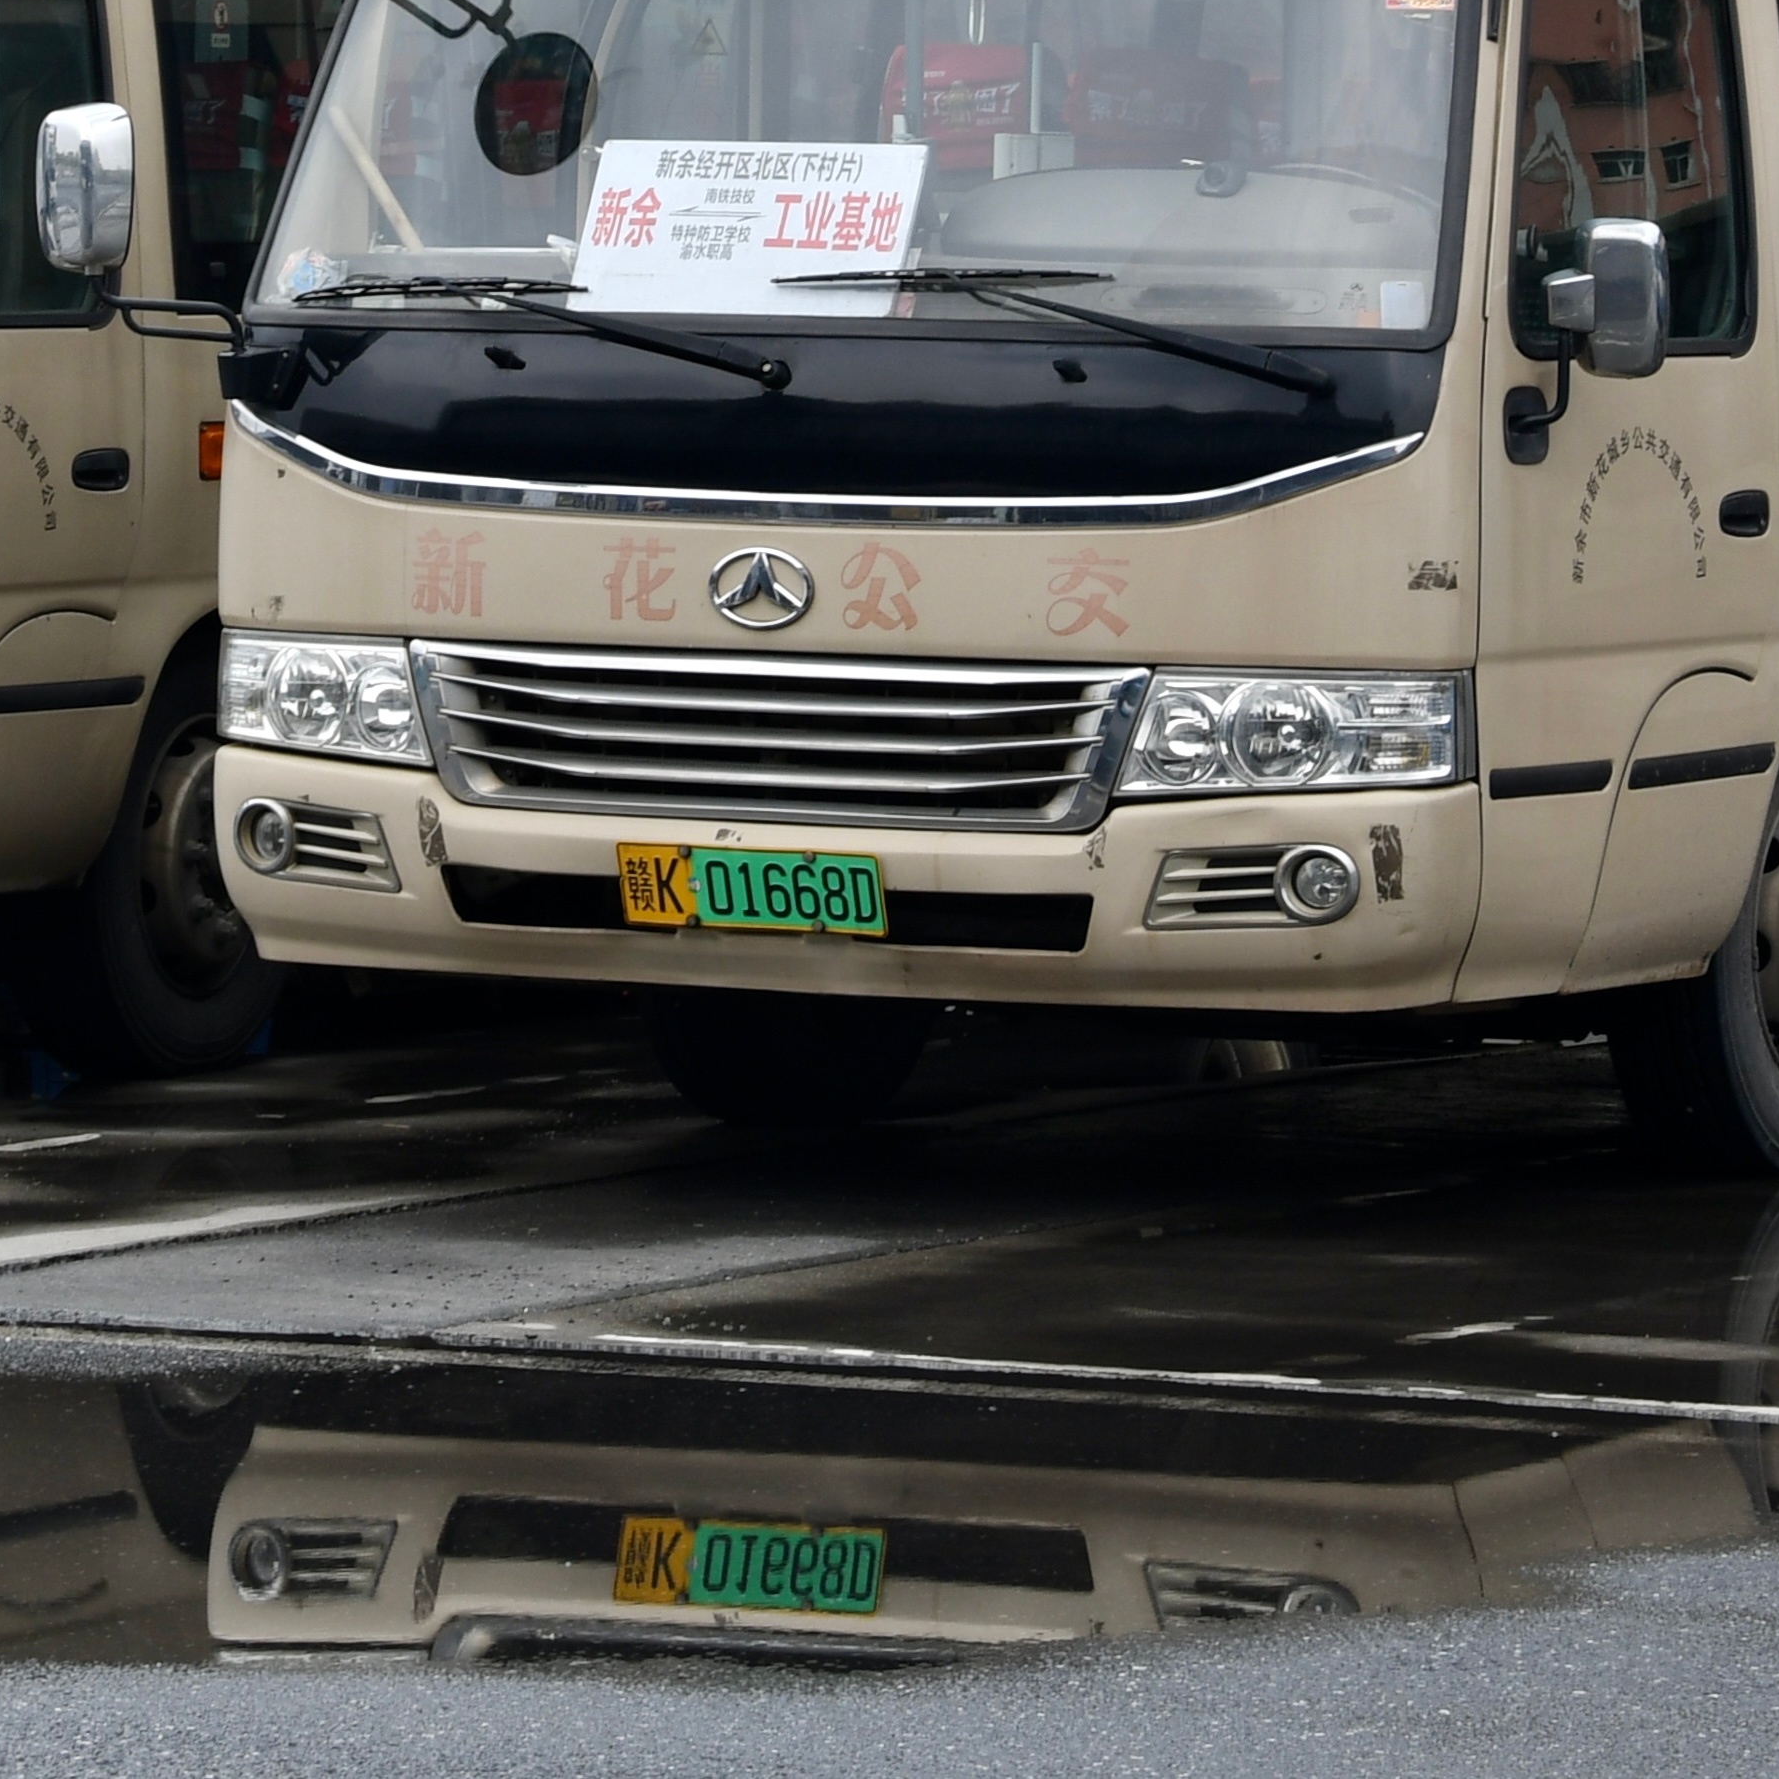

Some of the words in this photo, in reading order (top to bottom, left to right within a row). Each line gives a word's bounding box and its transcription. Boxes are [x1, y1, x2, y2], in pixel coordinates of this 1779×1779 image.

[655, 149, 863, 184] 新余经开区北区(下村片)
[591, 187, 662, 249] 新余
[763, 191, 904, 253] 工业基地
[705, 188, 755, 205] 南铁技校
[625, 856, 685, 914] 赣K
[705, 860, 878, 923] 01668D
